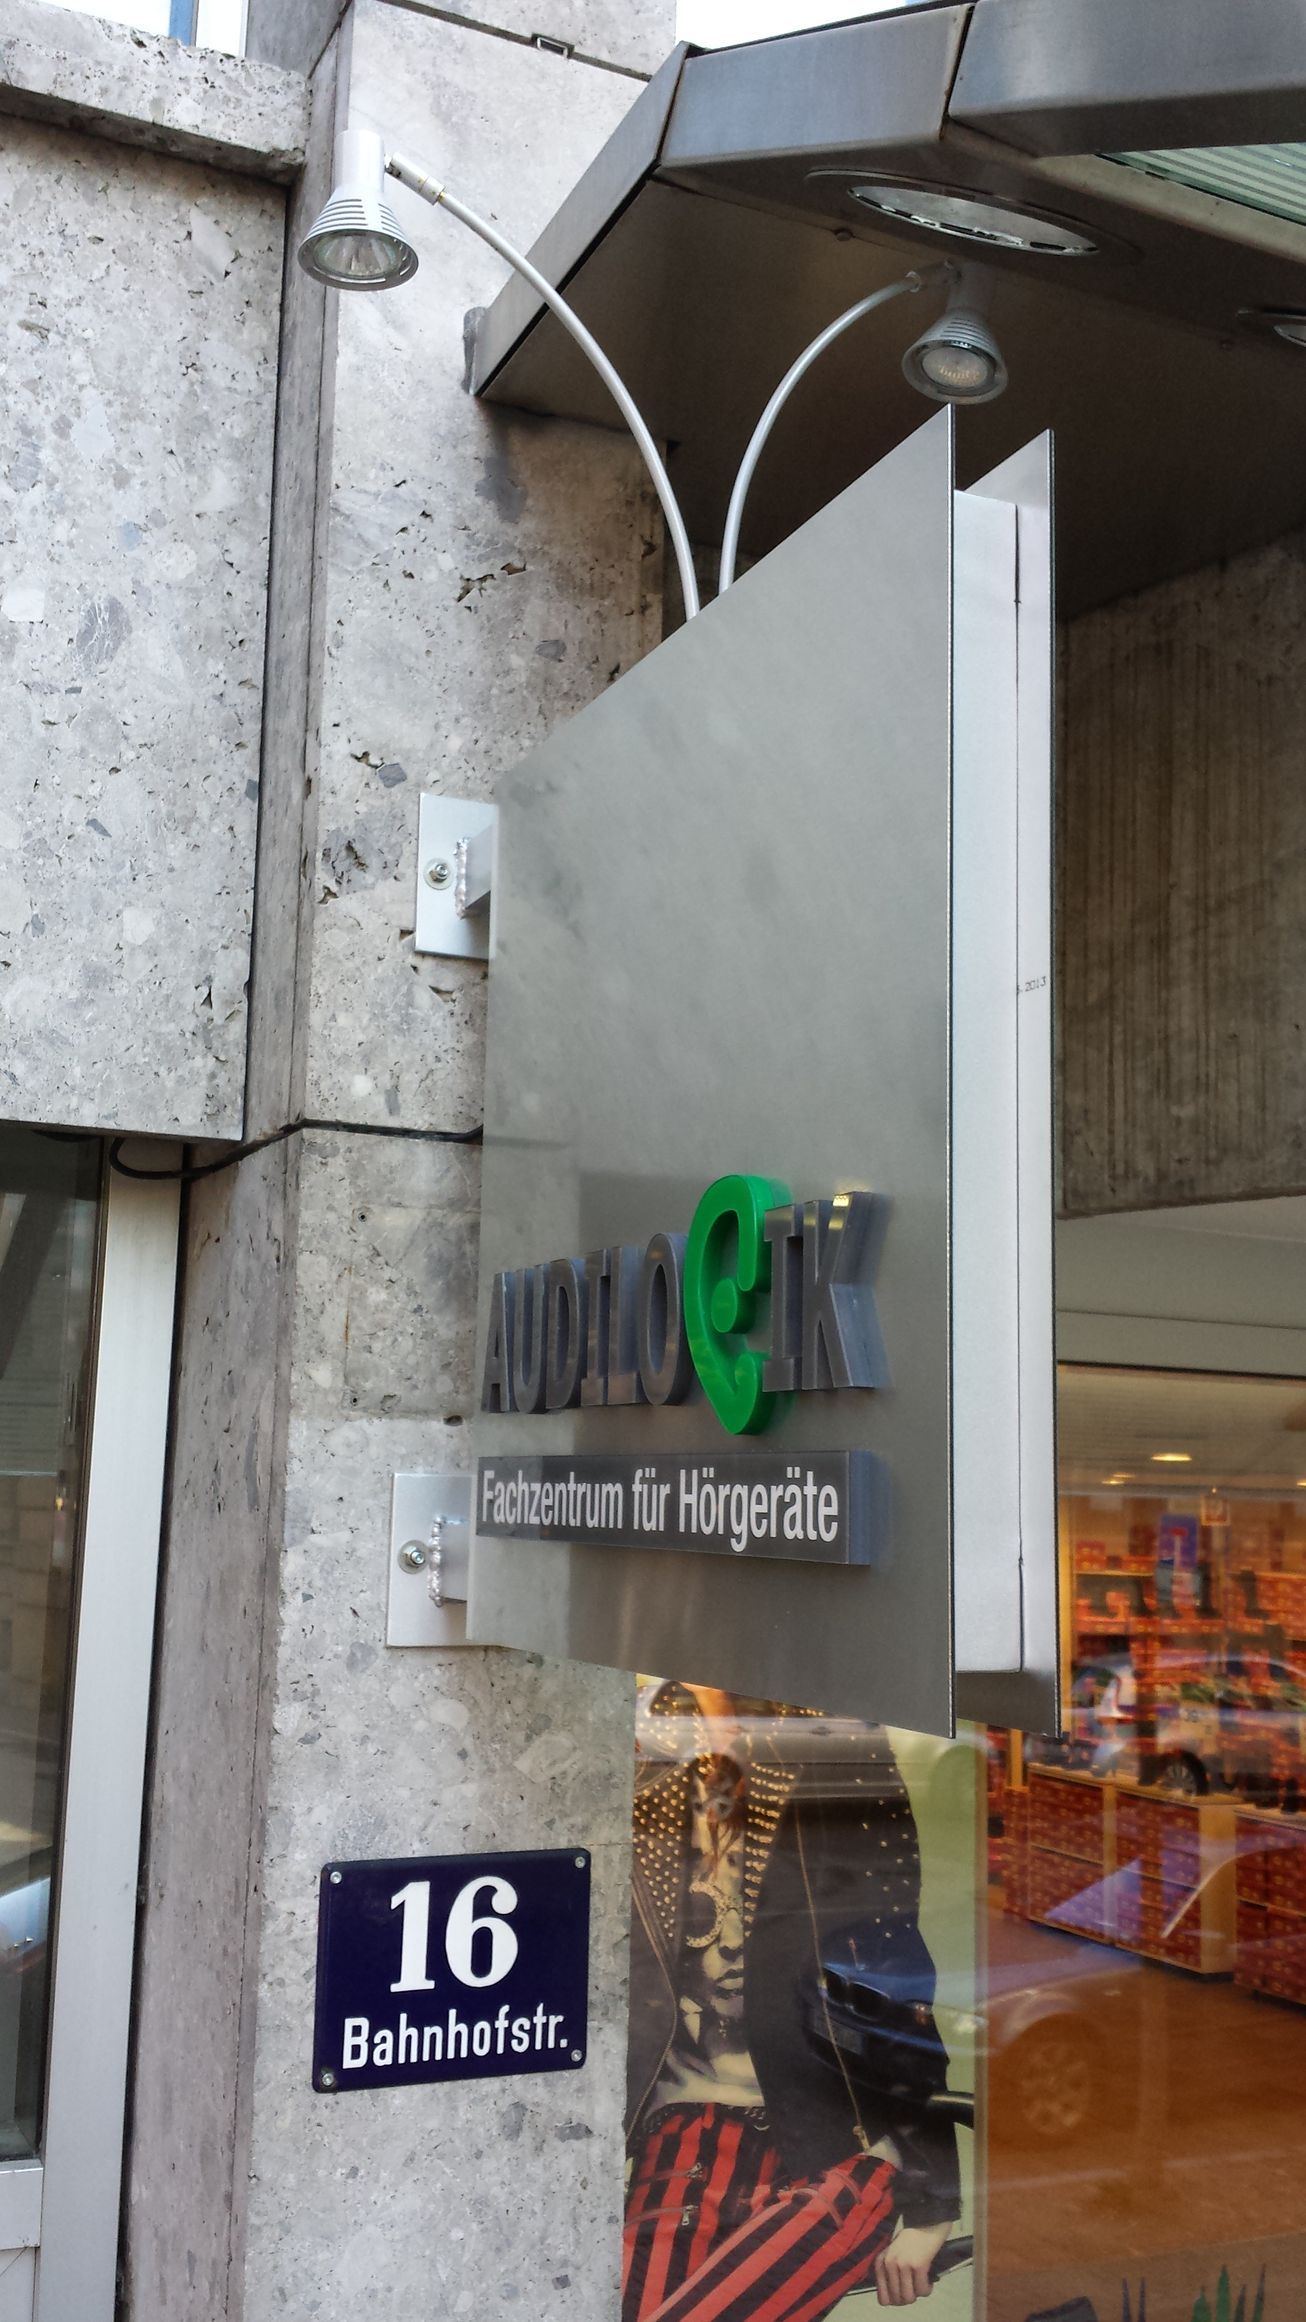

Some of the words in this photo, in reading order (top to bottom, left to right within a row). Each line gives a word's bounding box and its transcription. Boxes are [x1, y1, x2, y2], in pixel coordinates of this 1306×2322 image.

[482, 1469, 624, 1529] Fachzentrum
[632, 1467, 670, 1532] für
[678, 1466, 839, 1552] Hörgeräte
[390, 1876, 519, 1993] 16
[342, 2002, 568, 2069] Bahnhofstr.
